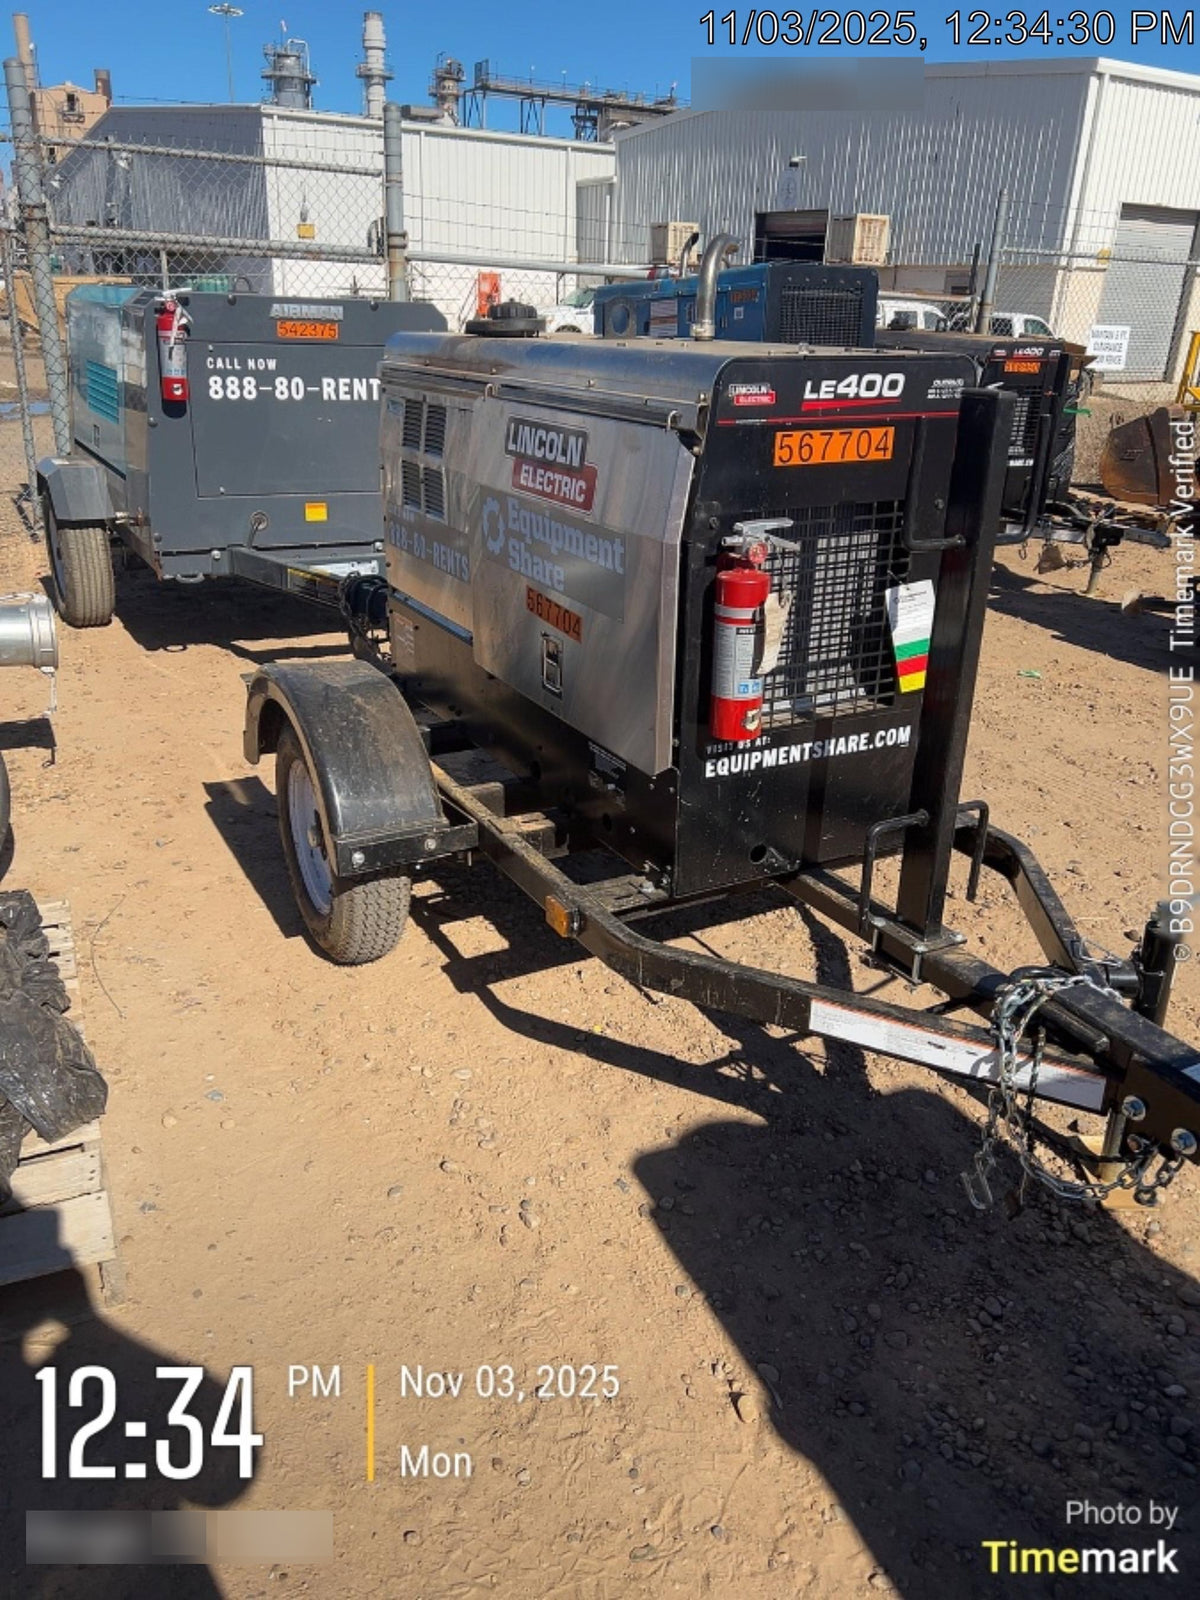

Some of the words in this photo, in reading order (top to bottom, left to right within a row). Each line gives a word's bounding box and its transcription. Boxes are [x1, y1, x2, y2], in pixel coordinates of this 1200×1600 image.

[279, 321, 337, 338] 542375
[206, 357, 241, 370] CALL
[248, 358, 277, 370] NOW
[804, 373, 905, 400] LE400
[508, 422, 584, 468] LINCOLN
[778, 429, 890, 464] 567704
[520, 463, 586, 503] ELECTRIC
[508, 498, 625, 575] Equipment
[508, 535, 565, 592] Share
[527, 588, 582, 637] 567704
[705, 725, 912, 778] EQUIPMENTSHARE.COM
